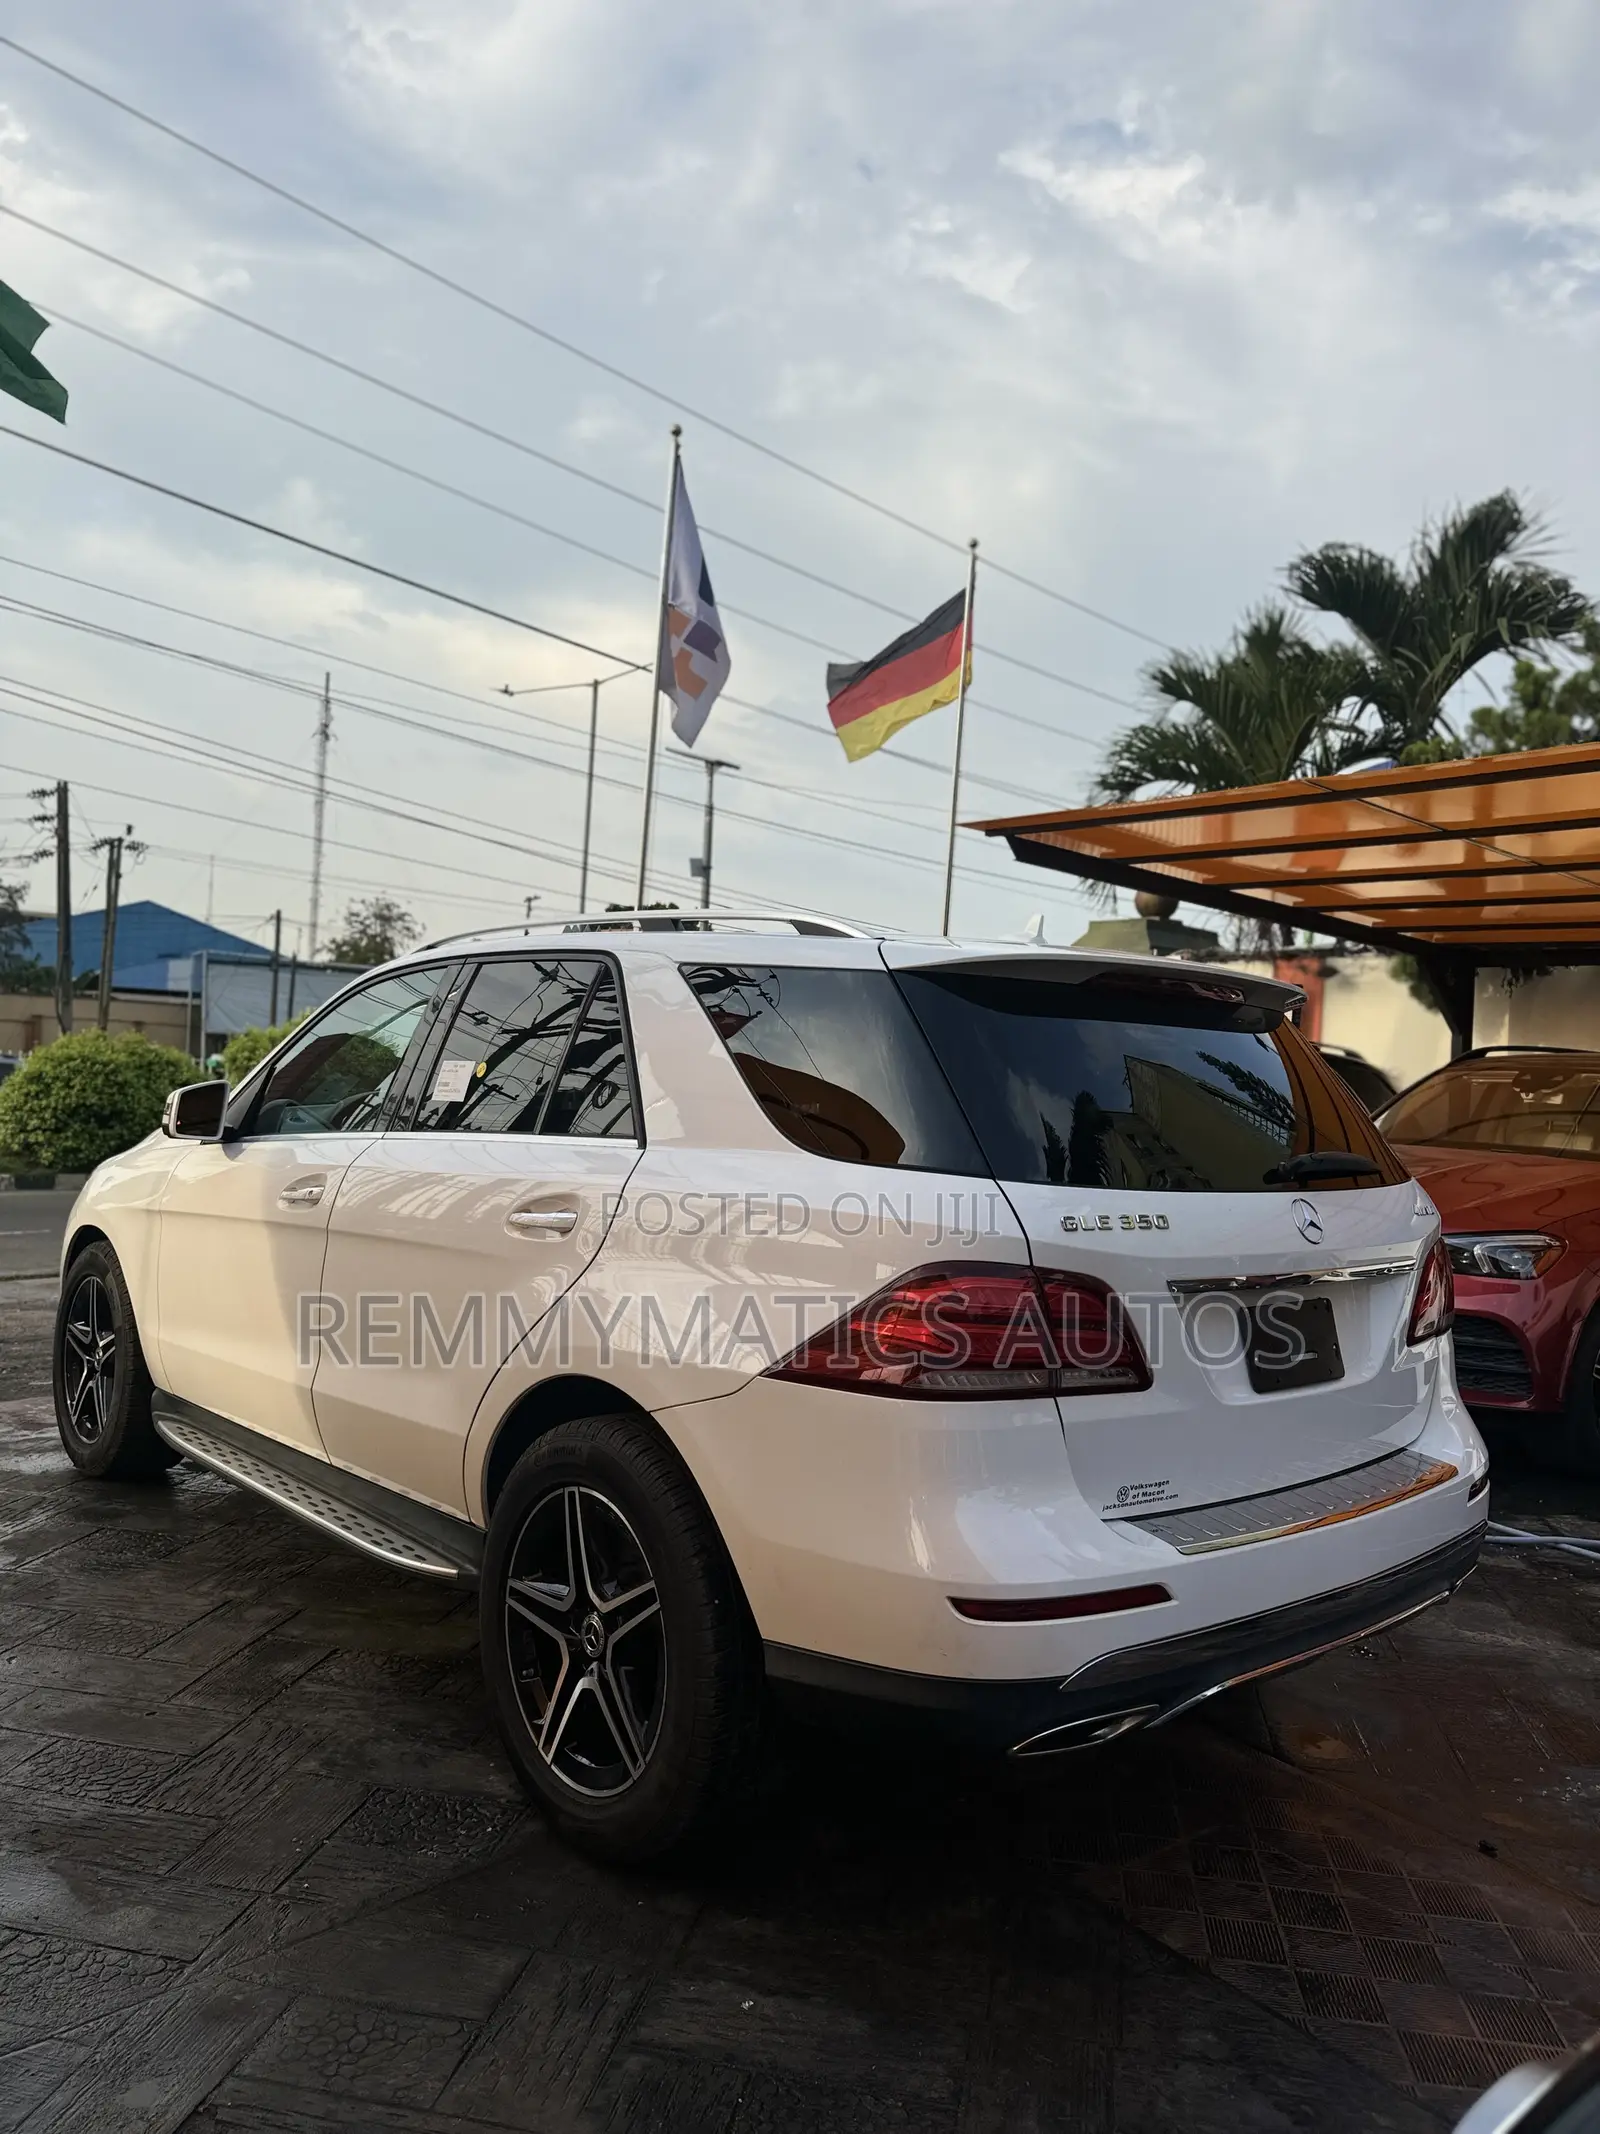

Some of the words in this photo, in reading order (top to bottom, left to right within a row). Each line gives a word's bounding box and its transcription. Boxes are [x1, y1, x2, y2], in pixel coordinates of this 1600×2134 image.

[1060, 1215, 1114, 1232] GLE
[1118, 1213, 1170, 1230] 350
[1129, 1480, 1170, 1491] Volkswagen
[1131, 1492, 1140, 1500] of
[1141, 1489, 1165, 1498] Macon
[1102, 1493, 1179, 1511] jacksonautomotive.com
